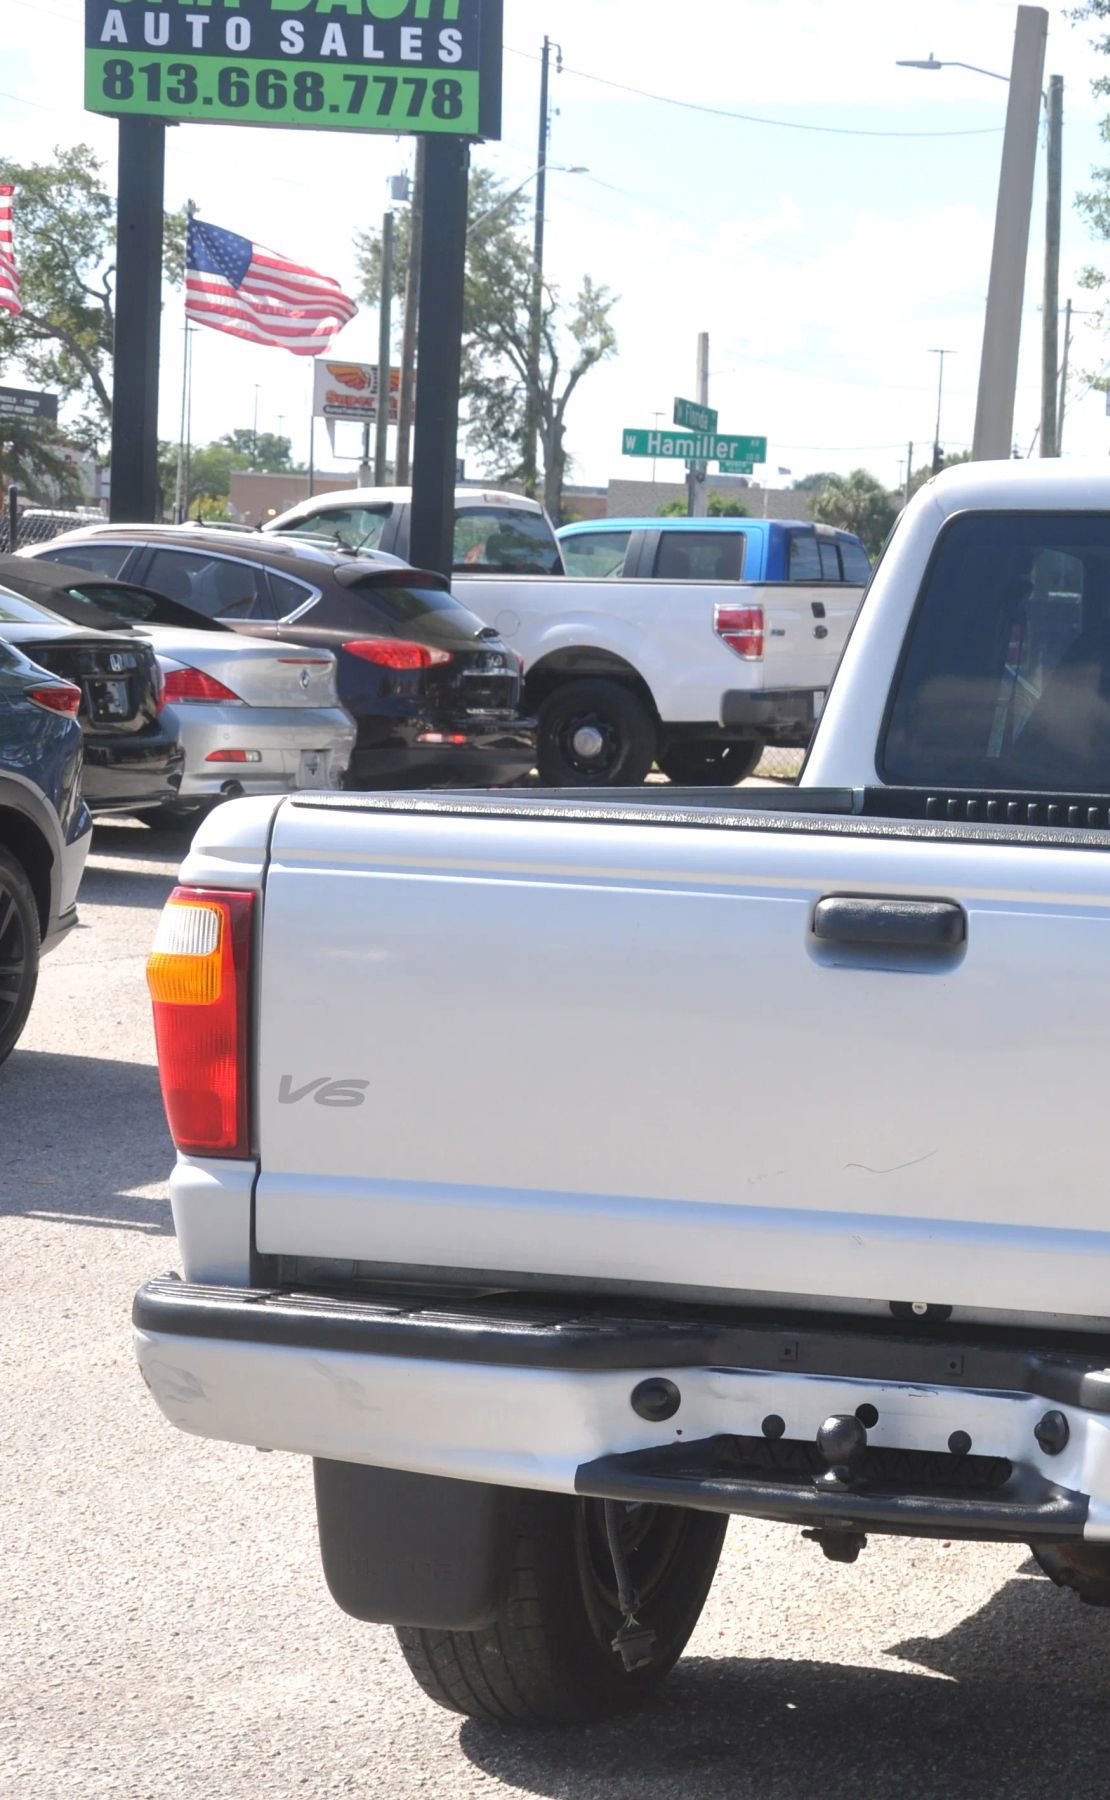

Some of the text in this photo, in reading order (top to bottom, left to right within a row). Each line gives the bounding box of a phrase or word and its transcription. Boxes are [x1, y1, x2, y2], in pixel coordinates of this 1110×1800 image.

[100, 9, 251, 51] AUTO
[280, 19, 463, 63] SALES
[102, 59, 463, 119] 813.668.7778
[626, 435, 636, 449] W
[648, 432, 738, 459] Hamiller
[278, 1075, 370, 1107] V6
